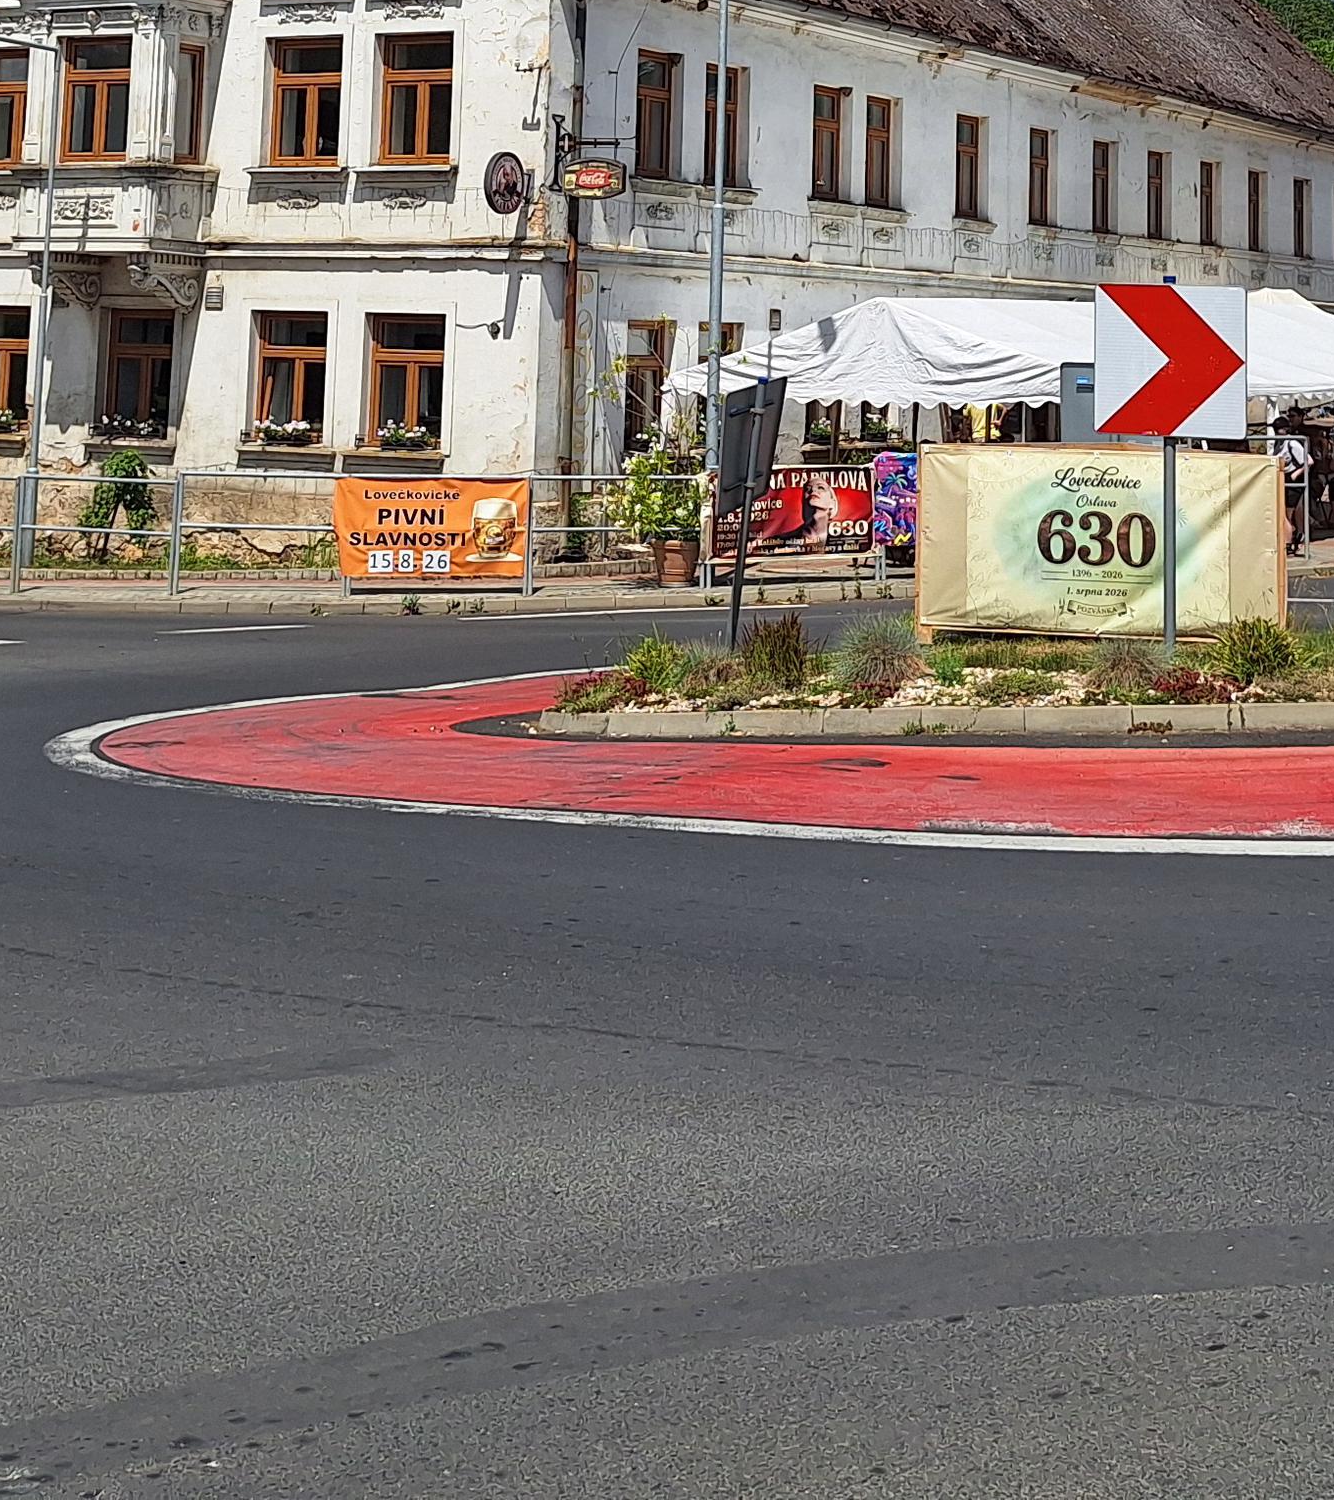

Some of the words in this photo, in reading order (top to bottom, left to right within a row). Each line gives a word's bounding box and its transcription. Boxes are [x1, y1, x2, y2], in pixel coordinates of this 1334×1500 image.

[1050, 466, 1142, 492] Lovečkovice
[364, 489, 461, 500] Lovečkovické
[1076, 494, 1118, 508] Oslava
[378, 504, 445, 525] PIVNÍ
[828, 520, 869, 536] 630
[349, 532, 466, 547] SLAVNOSTI
[1037, 509, 1156, 567] 630
[1072, 569, 1092, 578] 1396
[1102, 570, 1123, 579] 2026
[1076, 588, 1103, 597] srpna
[1105, 588, 1128, 597] 2026
